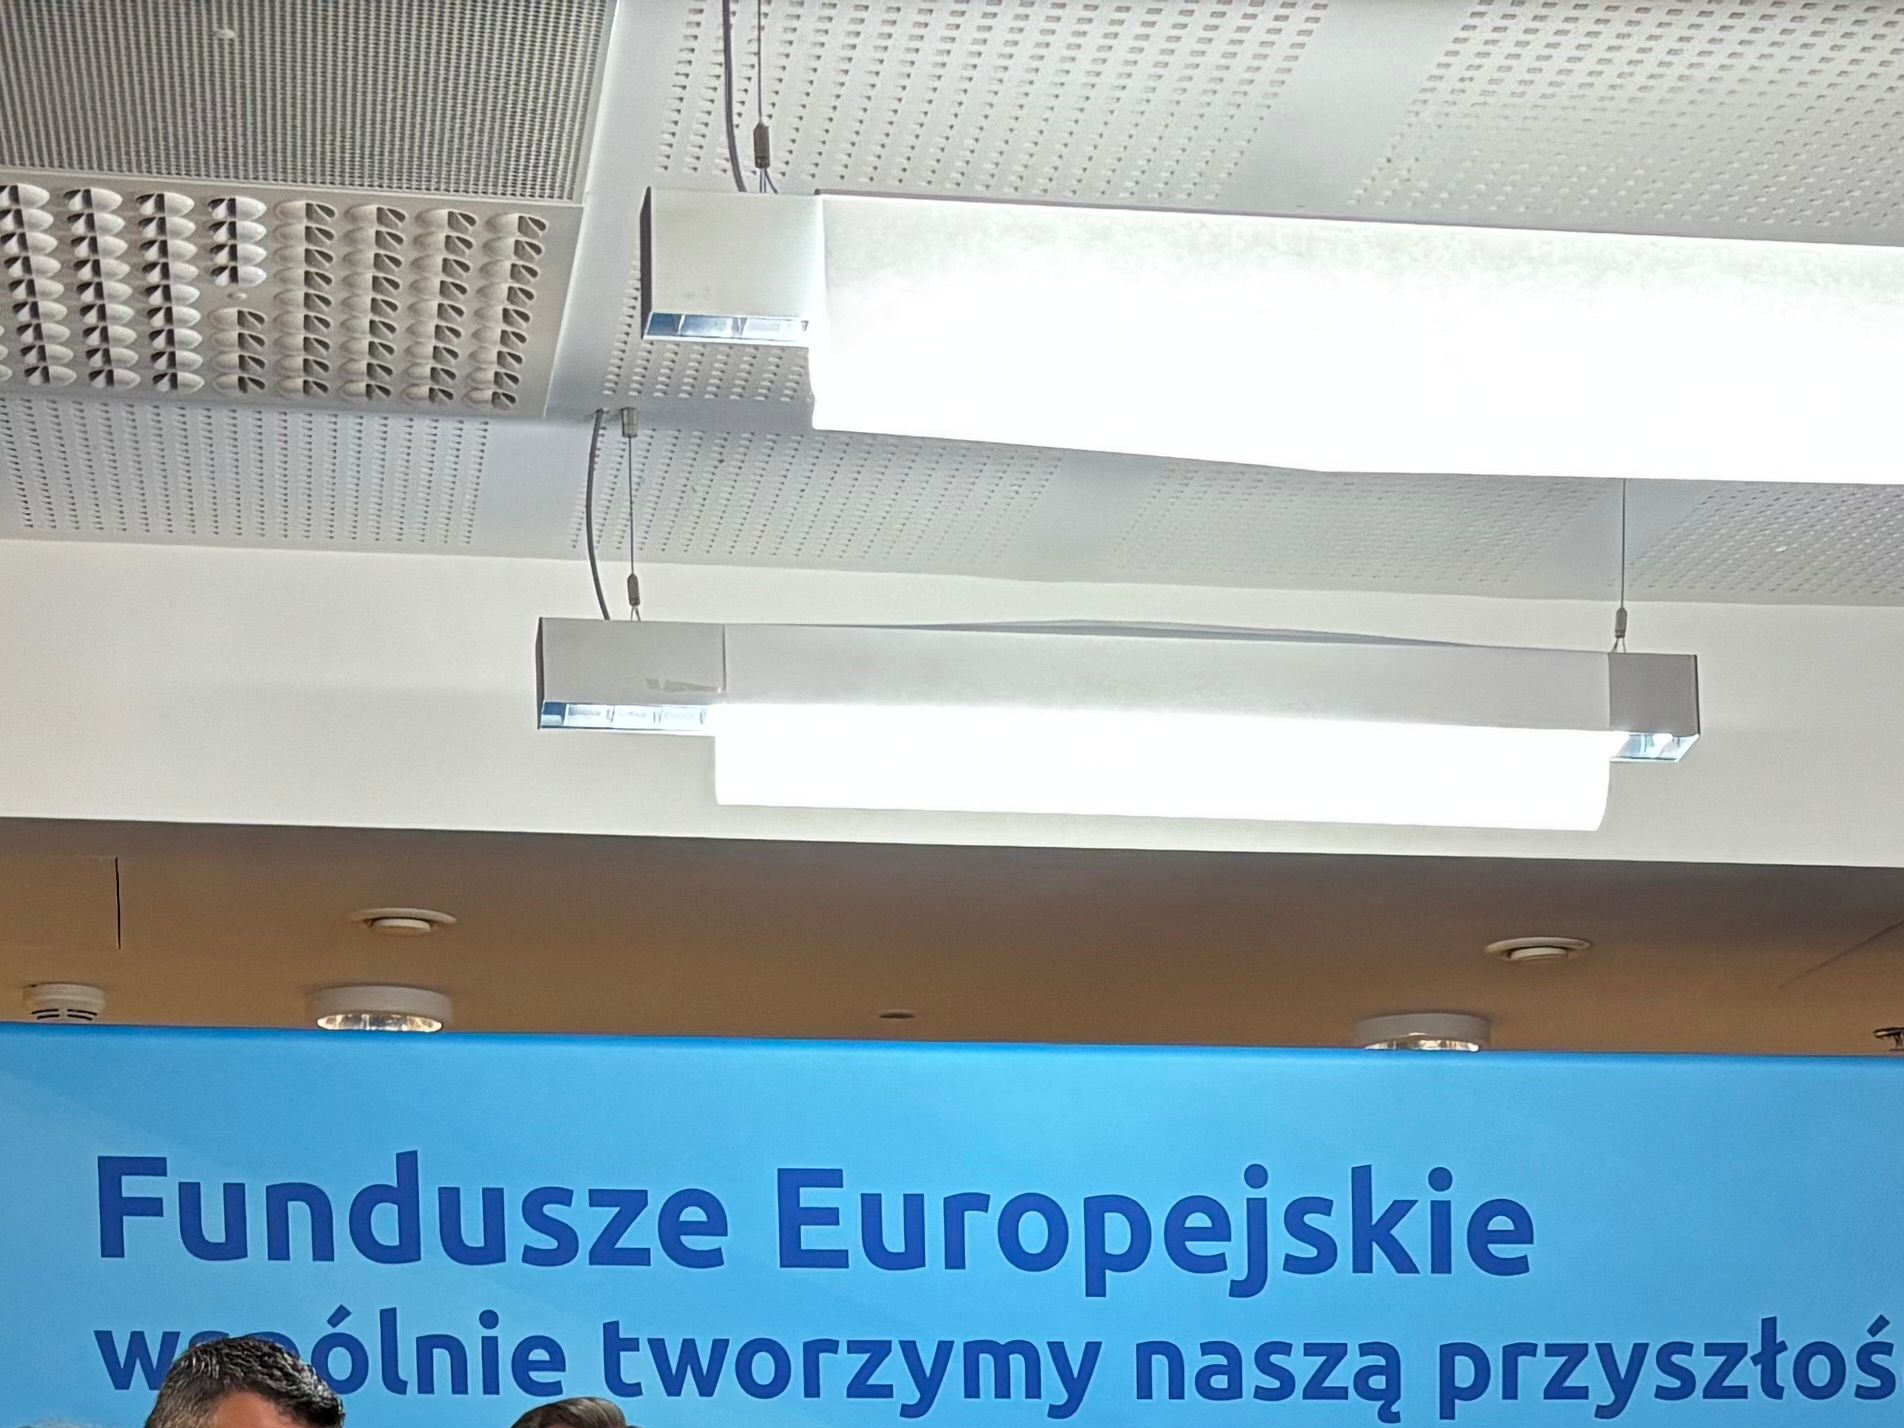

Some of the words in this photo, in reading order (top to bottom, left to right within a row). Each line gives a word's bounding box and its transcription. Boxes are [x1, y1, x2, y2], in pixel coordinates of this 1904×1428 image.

[96, 1149, 728, 1269] Fundusze
[776, 1162, 1534, 1299] Europejskie
[93, 1304, 567, 1397] wólnie
[602, 1320, 1103, 1420] tworzymy
[1135, 1340, 1402, 1424] naszą
